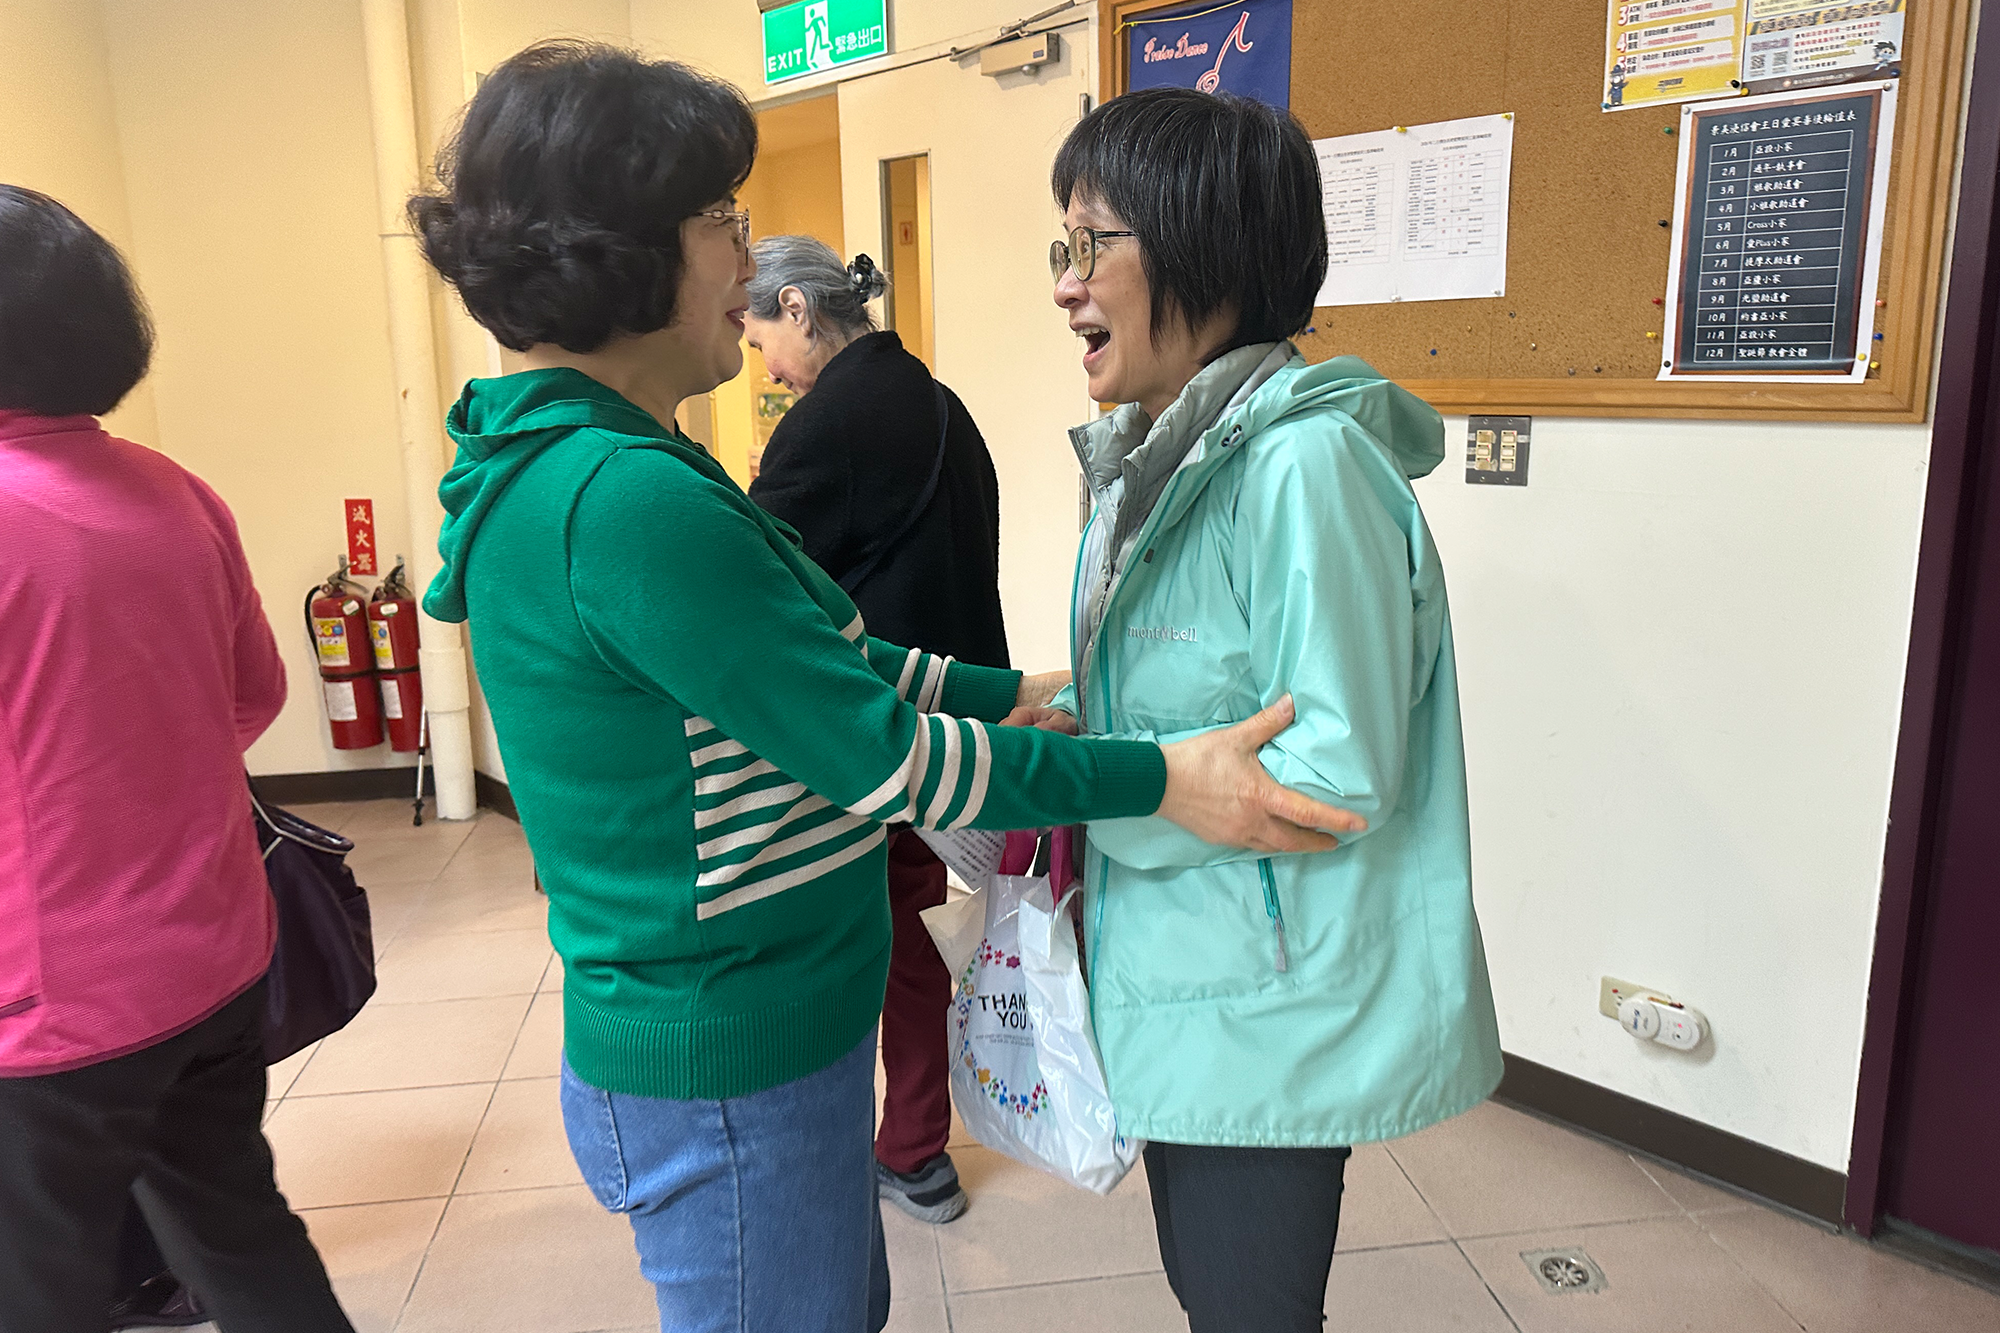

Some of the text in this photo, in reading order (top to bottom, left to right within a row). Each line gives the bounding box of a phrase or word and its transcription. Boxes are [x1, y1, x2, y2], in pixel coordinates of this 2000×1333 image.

[835, 24, 882, 55] 緊急出口
[1144, 32, 1208, 63] Praise Dance
[767, 48, 803, 73] EXIT
[1723, 147, 1738, 158] 1月
[1721, 166, 1736, 177] 2月
[1719, 184, 1735, 195] 3月
[1718, 203, 1733, 213] 4月
[1717, 221, 1731, 232] 5月
[1715, 240, 1730, 250] 6月
[1714, 258, 1728, 268] 7月
[1712, 276, 1727, 286] 8月
[1710, 294, 1725, 304] 9月
[1708, 312, 1726, 322] 10月
[1706, 330, 1725, 340] 11月
[1705, 348, 1724, 358] 12月
[1738, 347, 1766, 358] 聖誕節
[352, 504, 372, 571] 滅火器
[977, 993, 1028, 1012] THAN
[997, 1011, 1028, 1030] YOU
